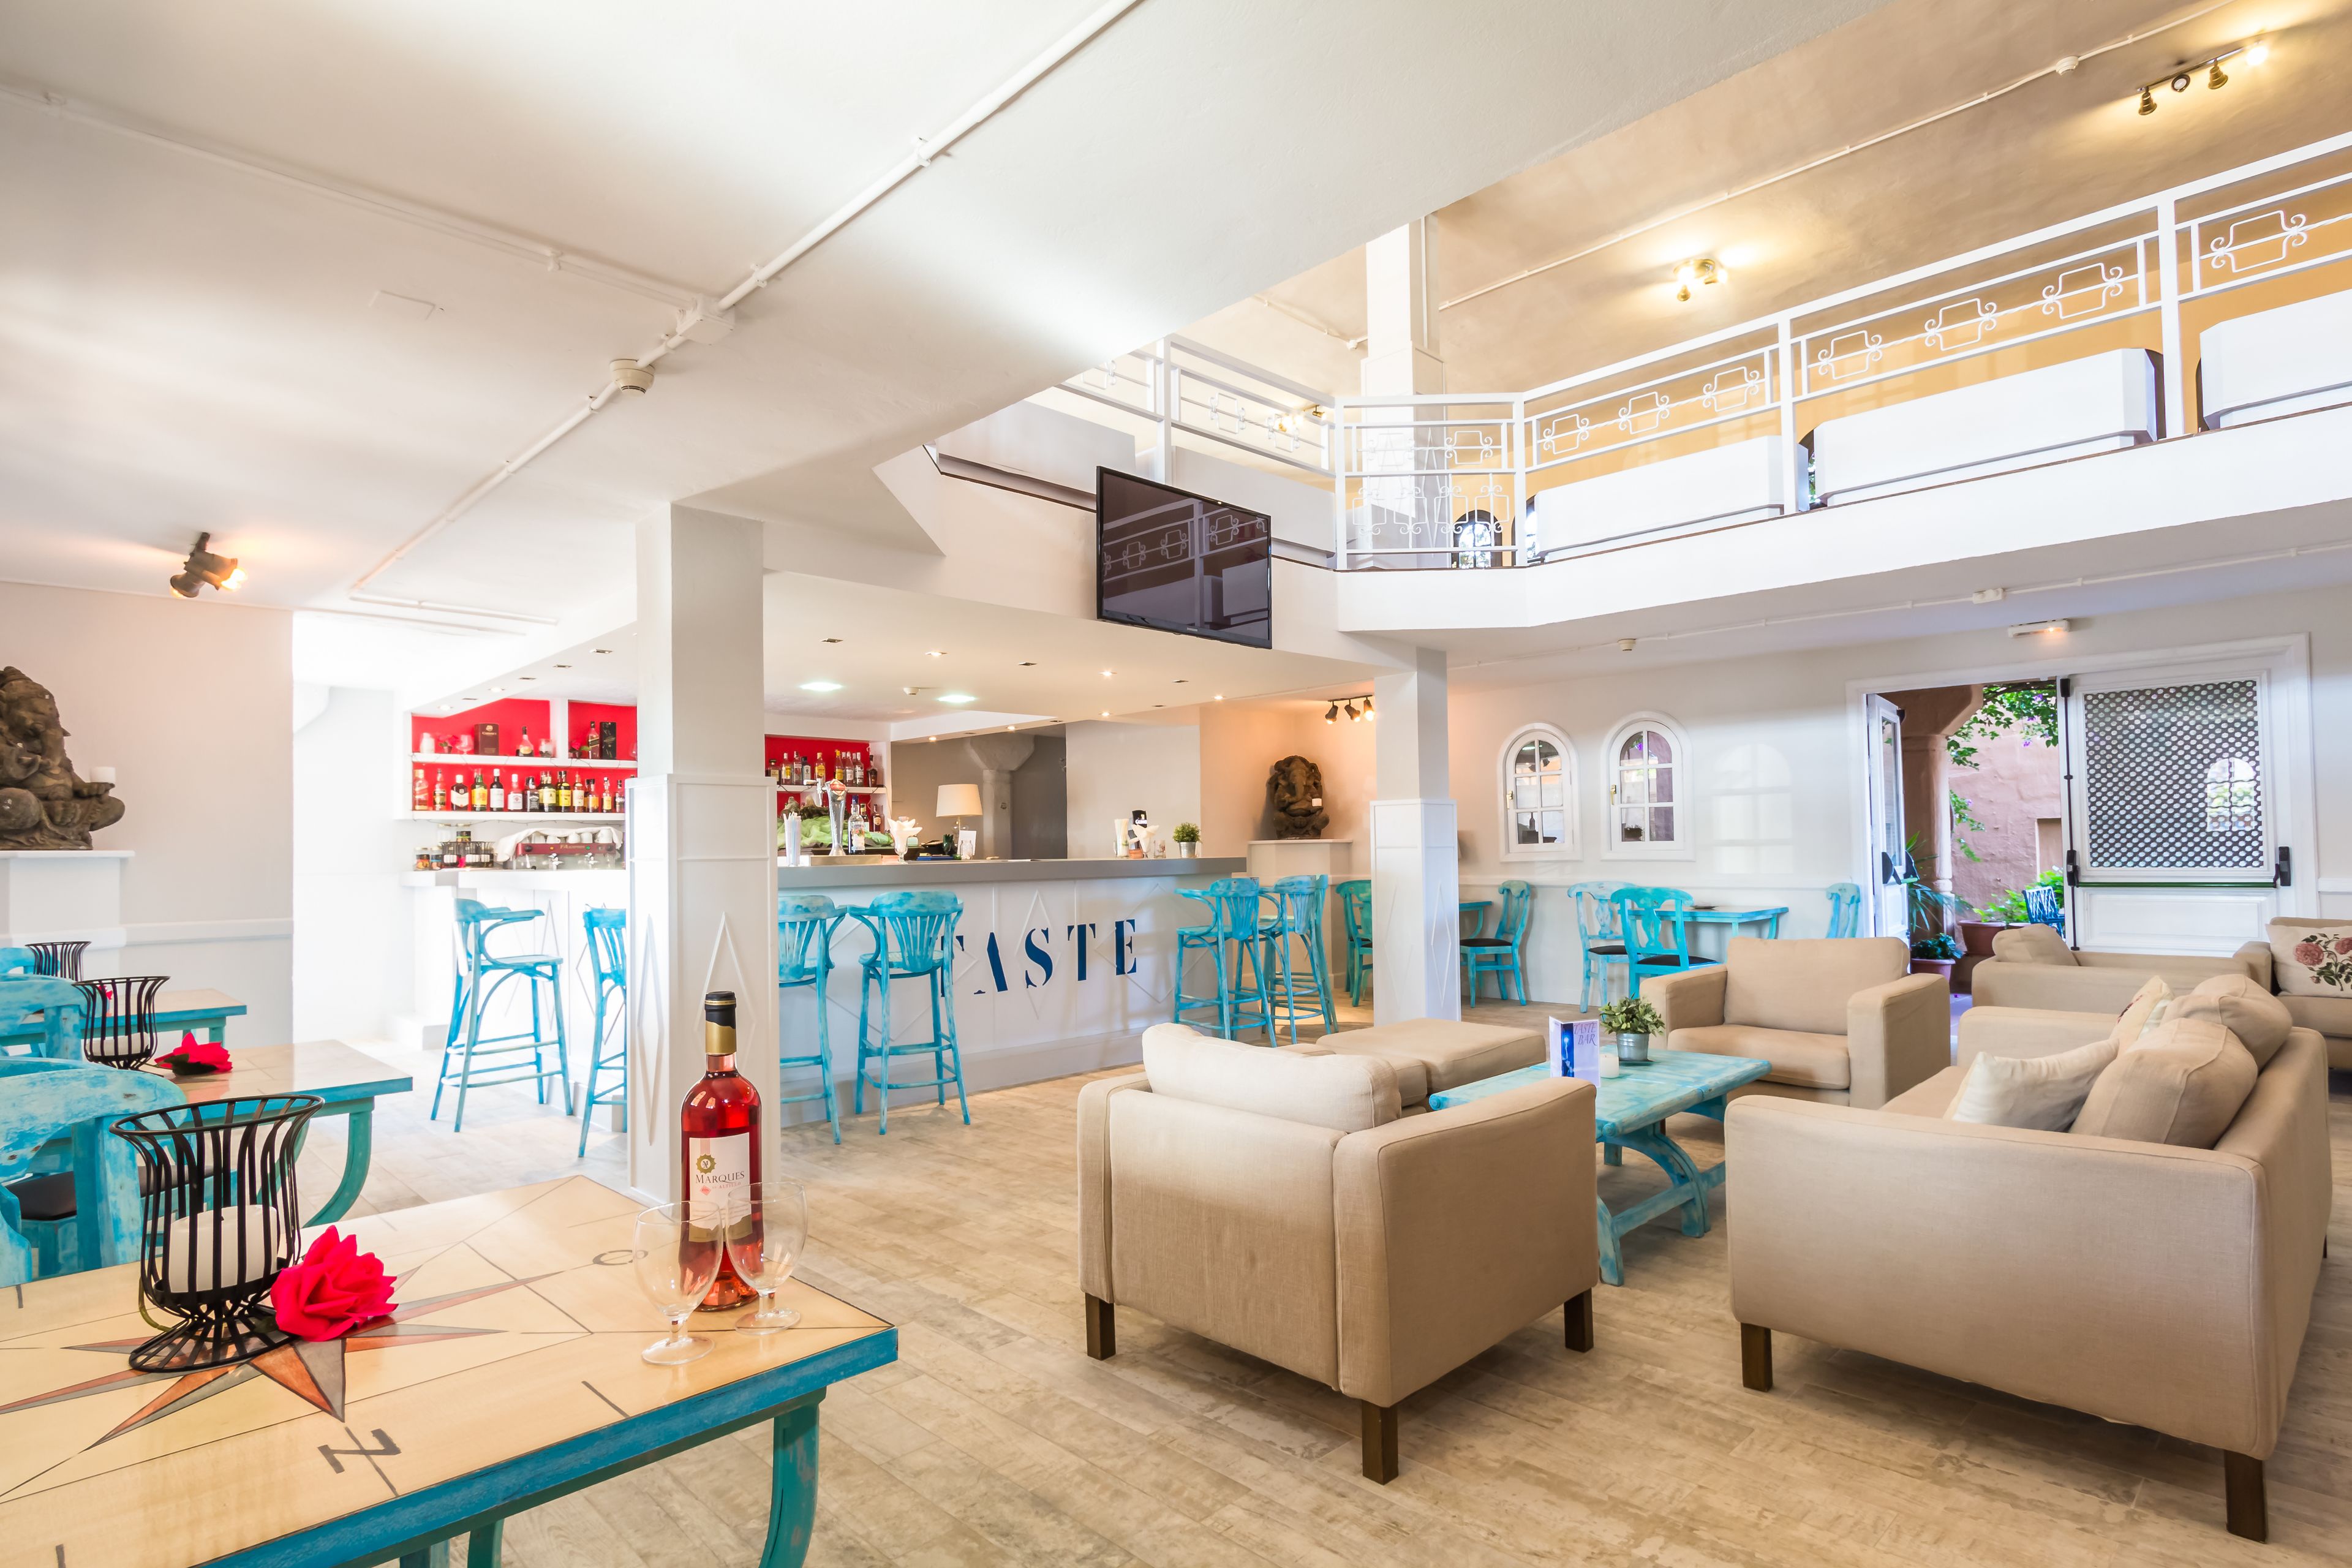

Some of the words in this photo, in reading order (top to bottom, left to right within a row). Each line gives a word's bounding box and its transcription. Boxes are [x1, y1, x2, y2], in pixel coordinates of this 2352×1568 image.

[1574, 1022, 1597, 1035] TASTE
[1578, 1033, 1597, 1046] BAR
[695, 1170, 745, 1184] MARQUES
